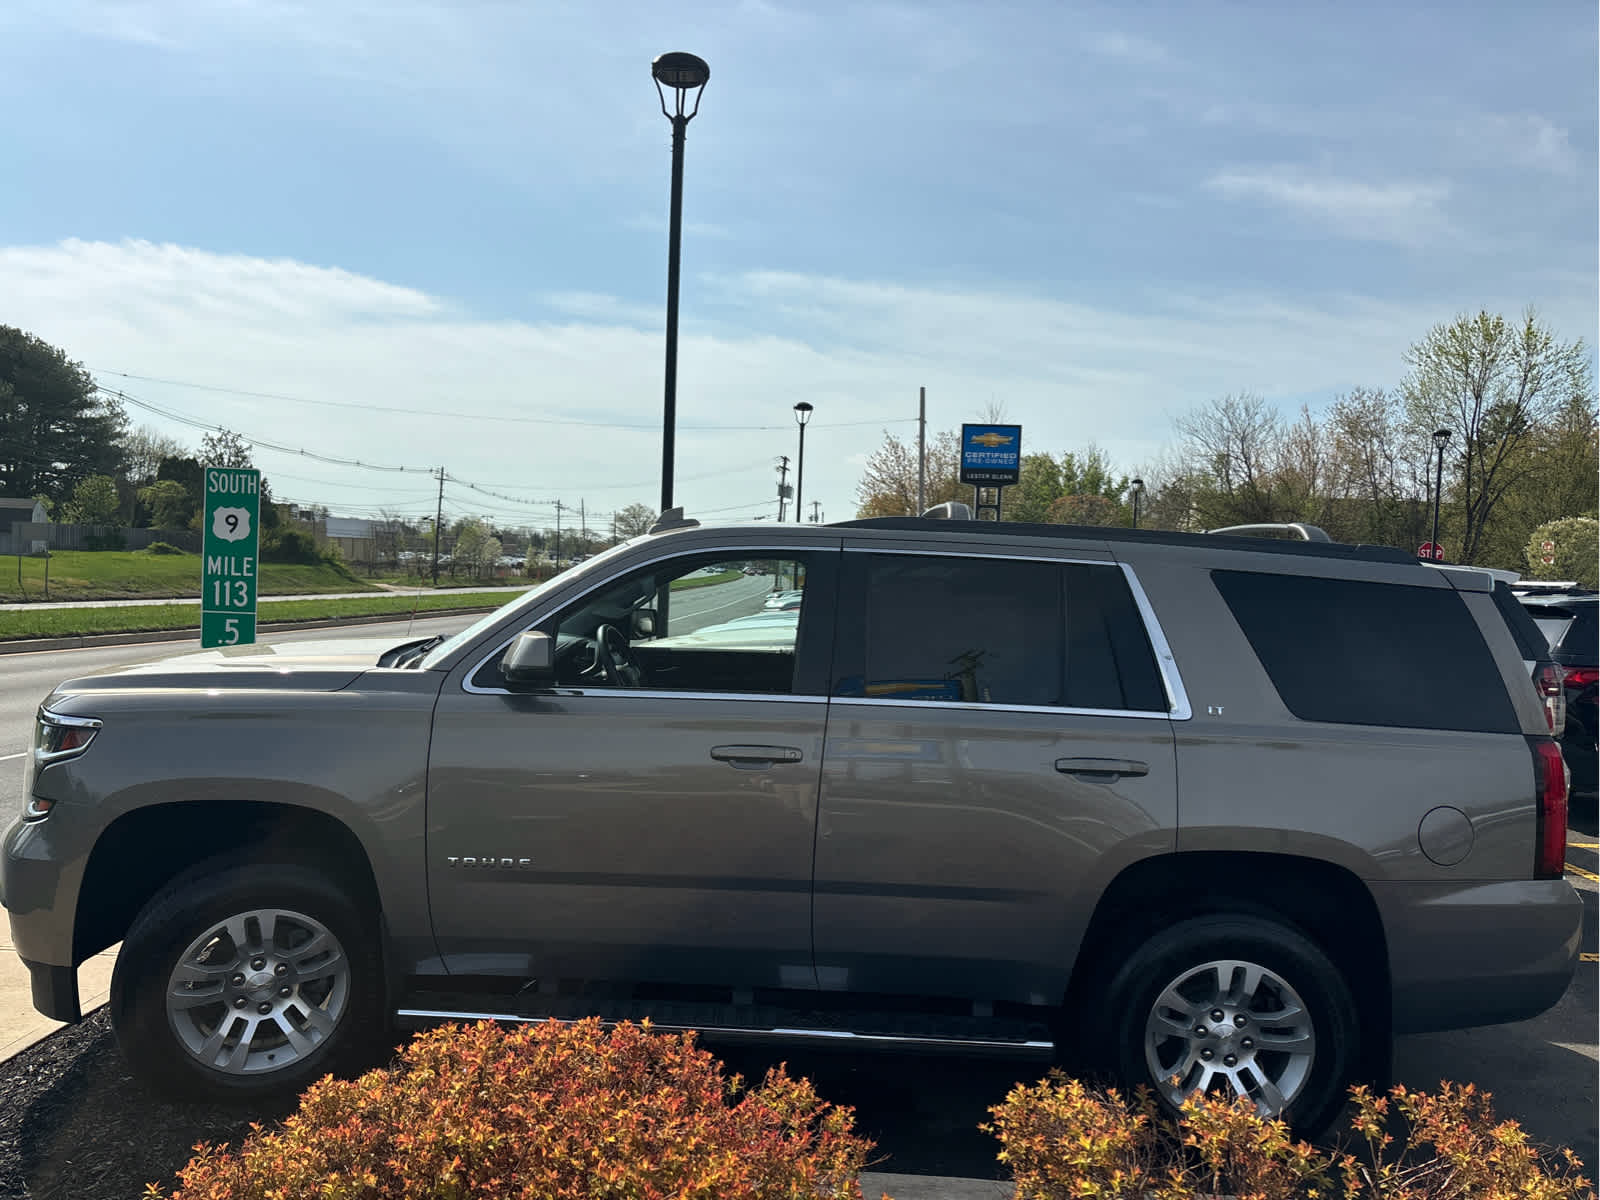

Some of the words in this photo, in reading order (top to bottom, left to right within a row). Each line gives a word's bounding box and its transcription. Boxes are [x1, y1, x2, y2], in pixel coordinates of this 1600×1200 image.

[208, 471, 257, 494] SOUTH
[224, 513, 239, 534] 9
[1420, 549, 1442, 559] STP
[207, 556, 253, 577] MILE
[213, 580, 248, 607] 113
[218, 619, 240, 645] .5
[1208, 705, 1224, 716] LT
[447, 856, 531, 866] TAHOE
